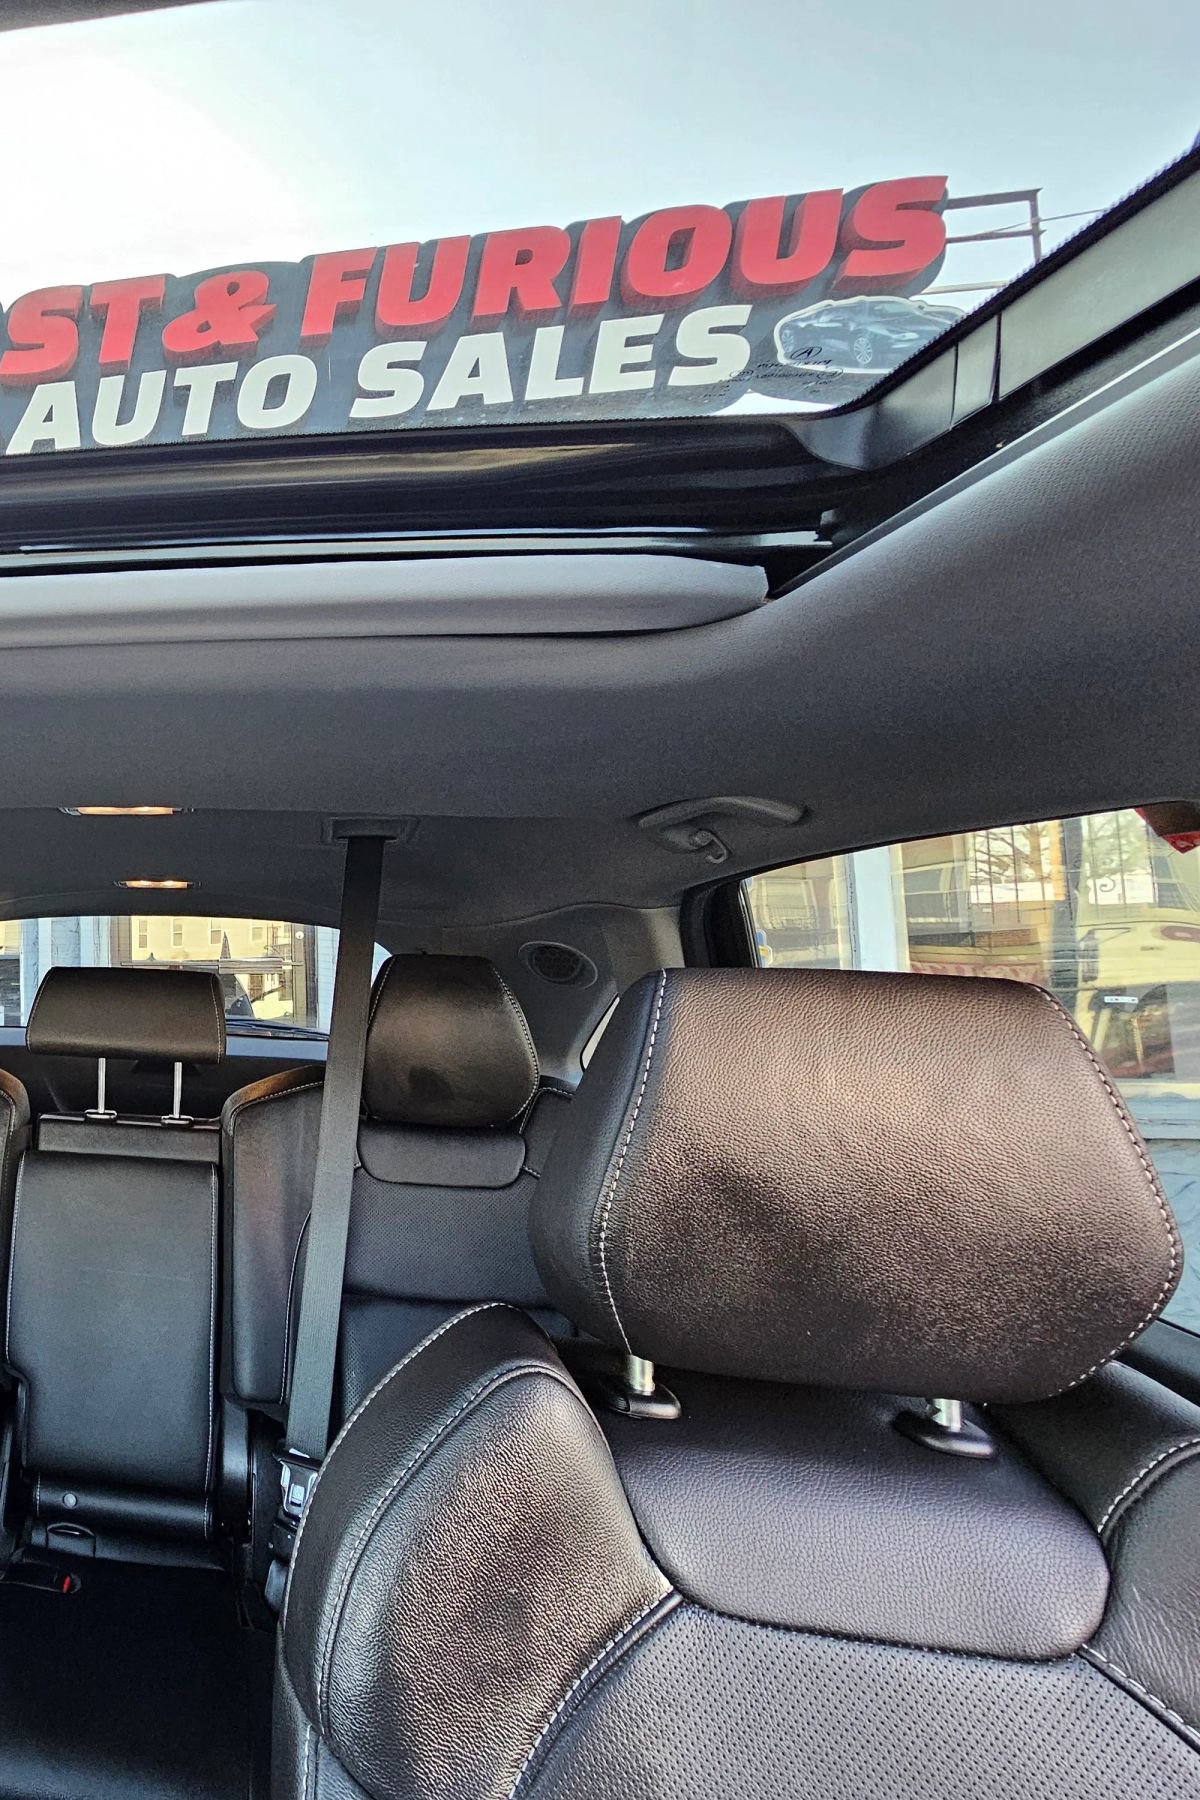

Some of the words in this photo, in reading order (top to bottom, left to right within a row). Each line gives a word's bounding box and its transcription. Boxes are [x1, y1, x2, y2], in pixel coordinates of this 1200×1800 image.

[163, 269, 276, 360] &
[300, 175, 949, 346] FURIOUS
[5, 354, 318, 456] AUTO
[349, 304, 754, 420] SALES
